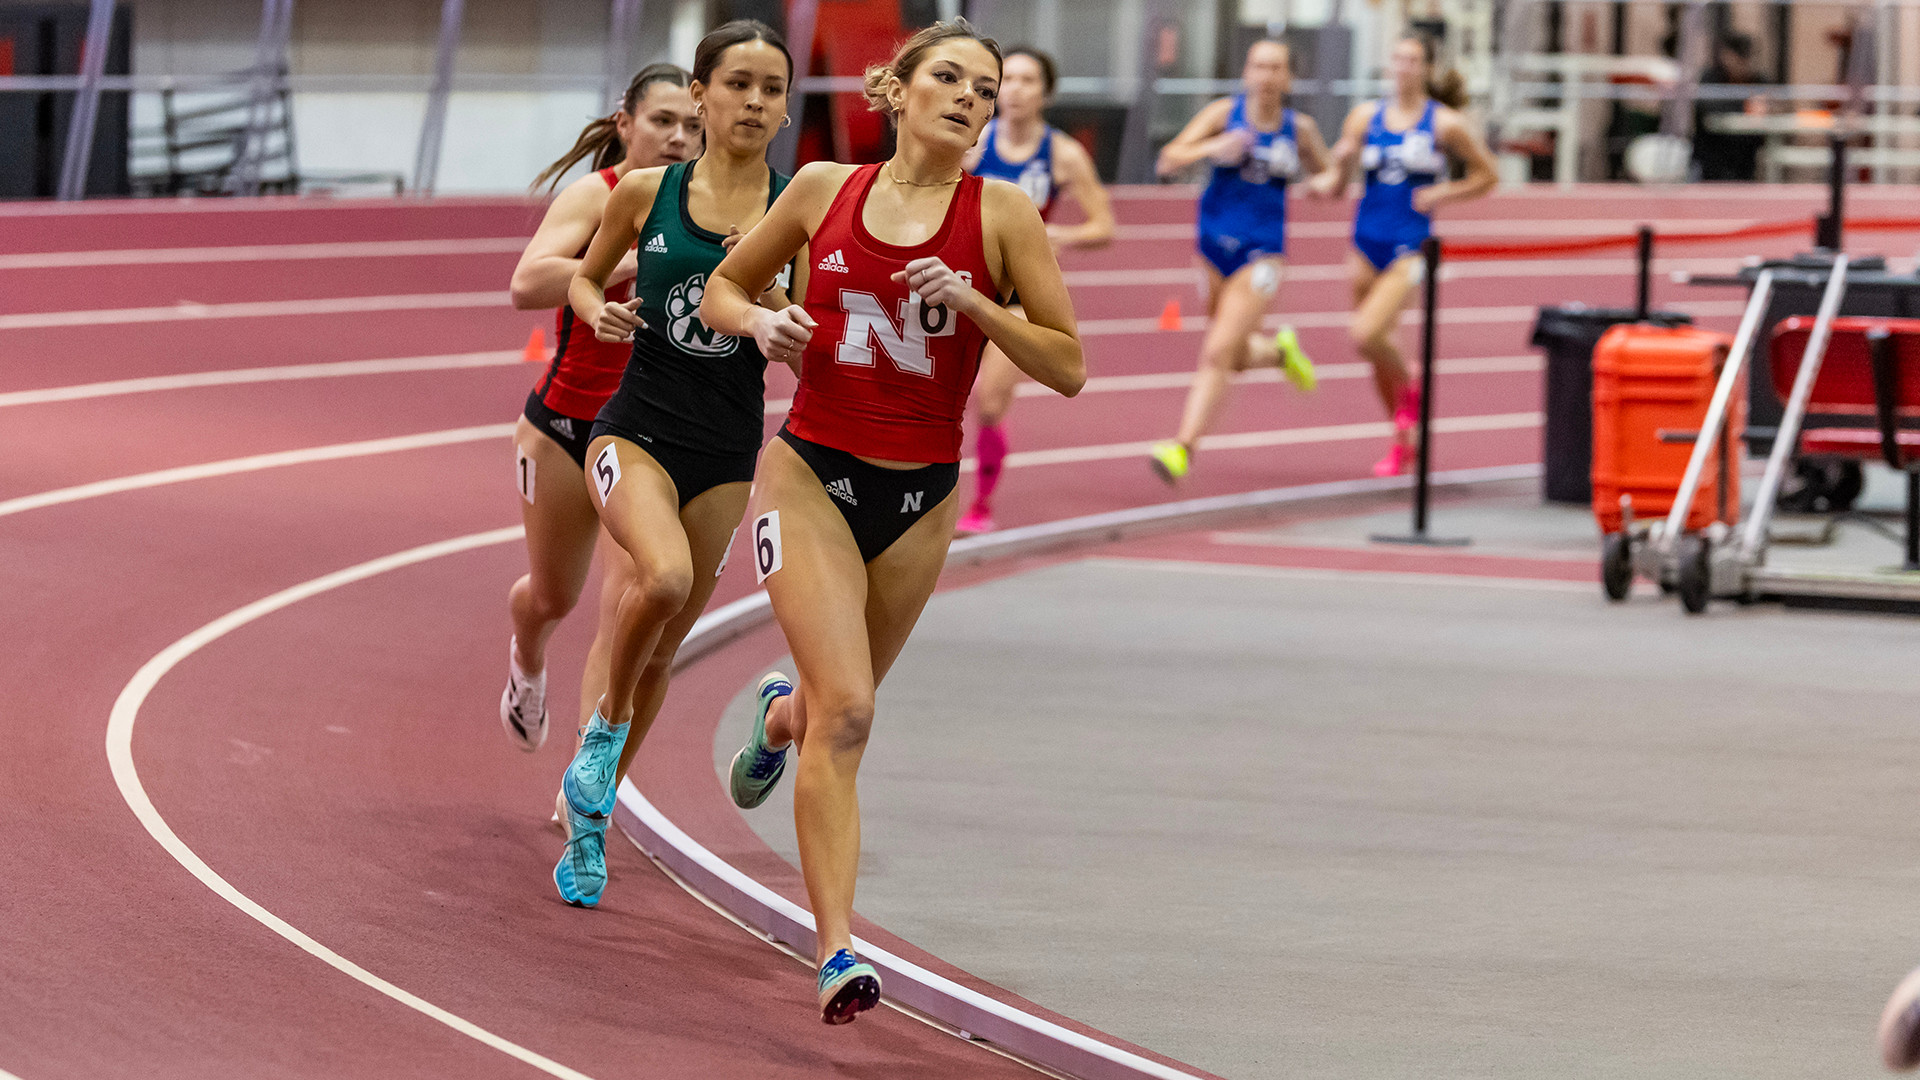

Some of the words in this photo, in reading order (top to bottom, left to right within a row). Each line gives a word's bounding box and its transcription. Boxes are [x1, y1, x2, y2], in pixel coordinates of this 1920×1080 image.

[645, 245, 668, 254] adidas
[818, 261, 849, 274] adidas
[680, 315, 716, 346] N
[835, 287, 935, 379] N
[520, 457, 528, 496] 1
[596, 450, 614, 497] 5
[825, 484, 858, 506] adidas
[900, 490, 924, 513] N
[756, 517, 774, 576] 6
